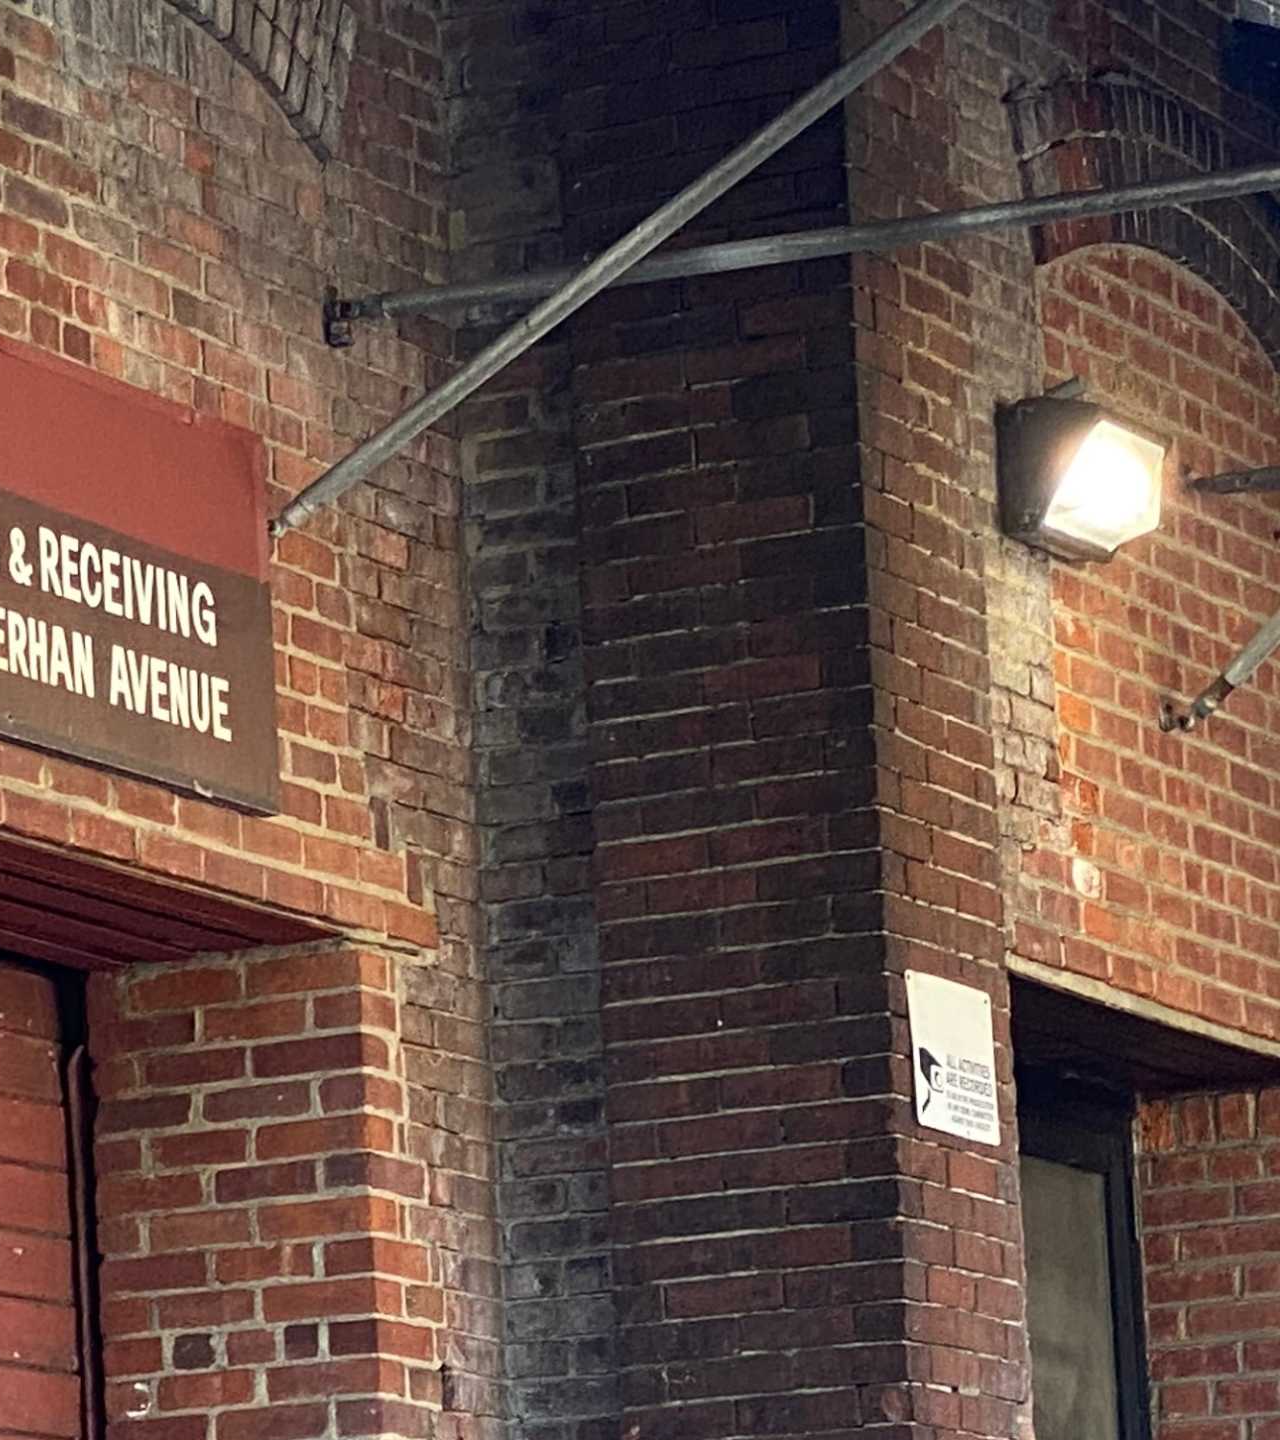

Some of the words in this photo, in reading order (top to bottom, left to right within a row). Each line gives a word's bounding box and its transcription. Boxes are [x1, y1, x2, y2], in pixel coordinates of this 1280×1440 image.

[8, 527, 34, 587] &
[38, 526, 217, 647] RECEIVING
[109, 644, 232, 742] AVENUE
